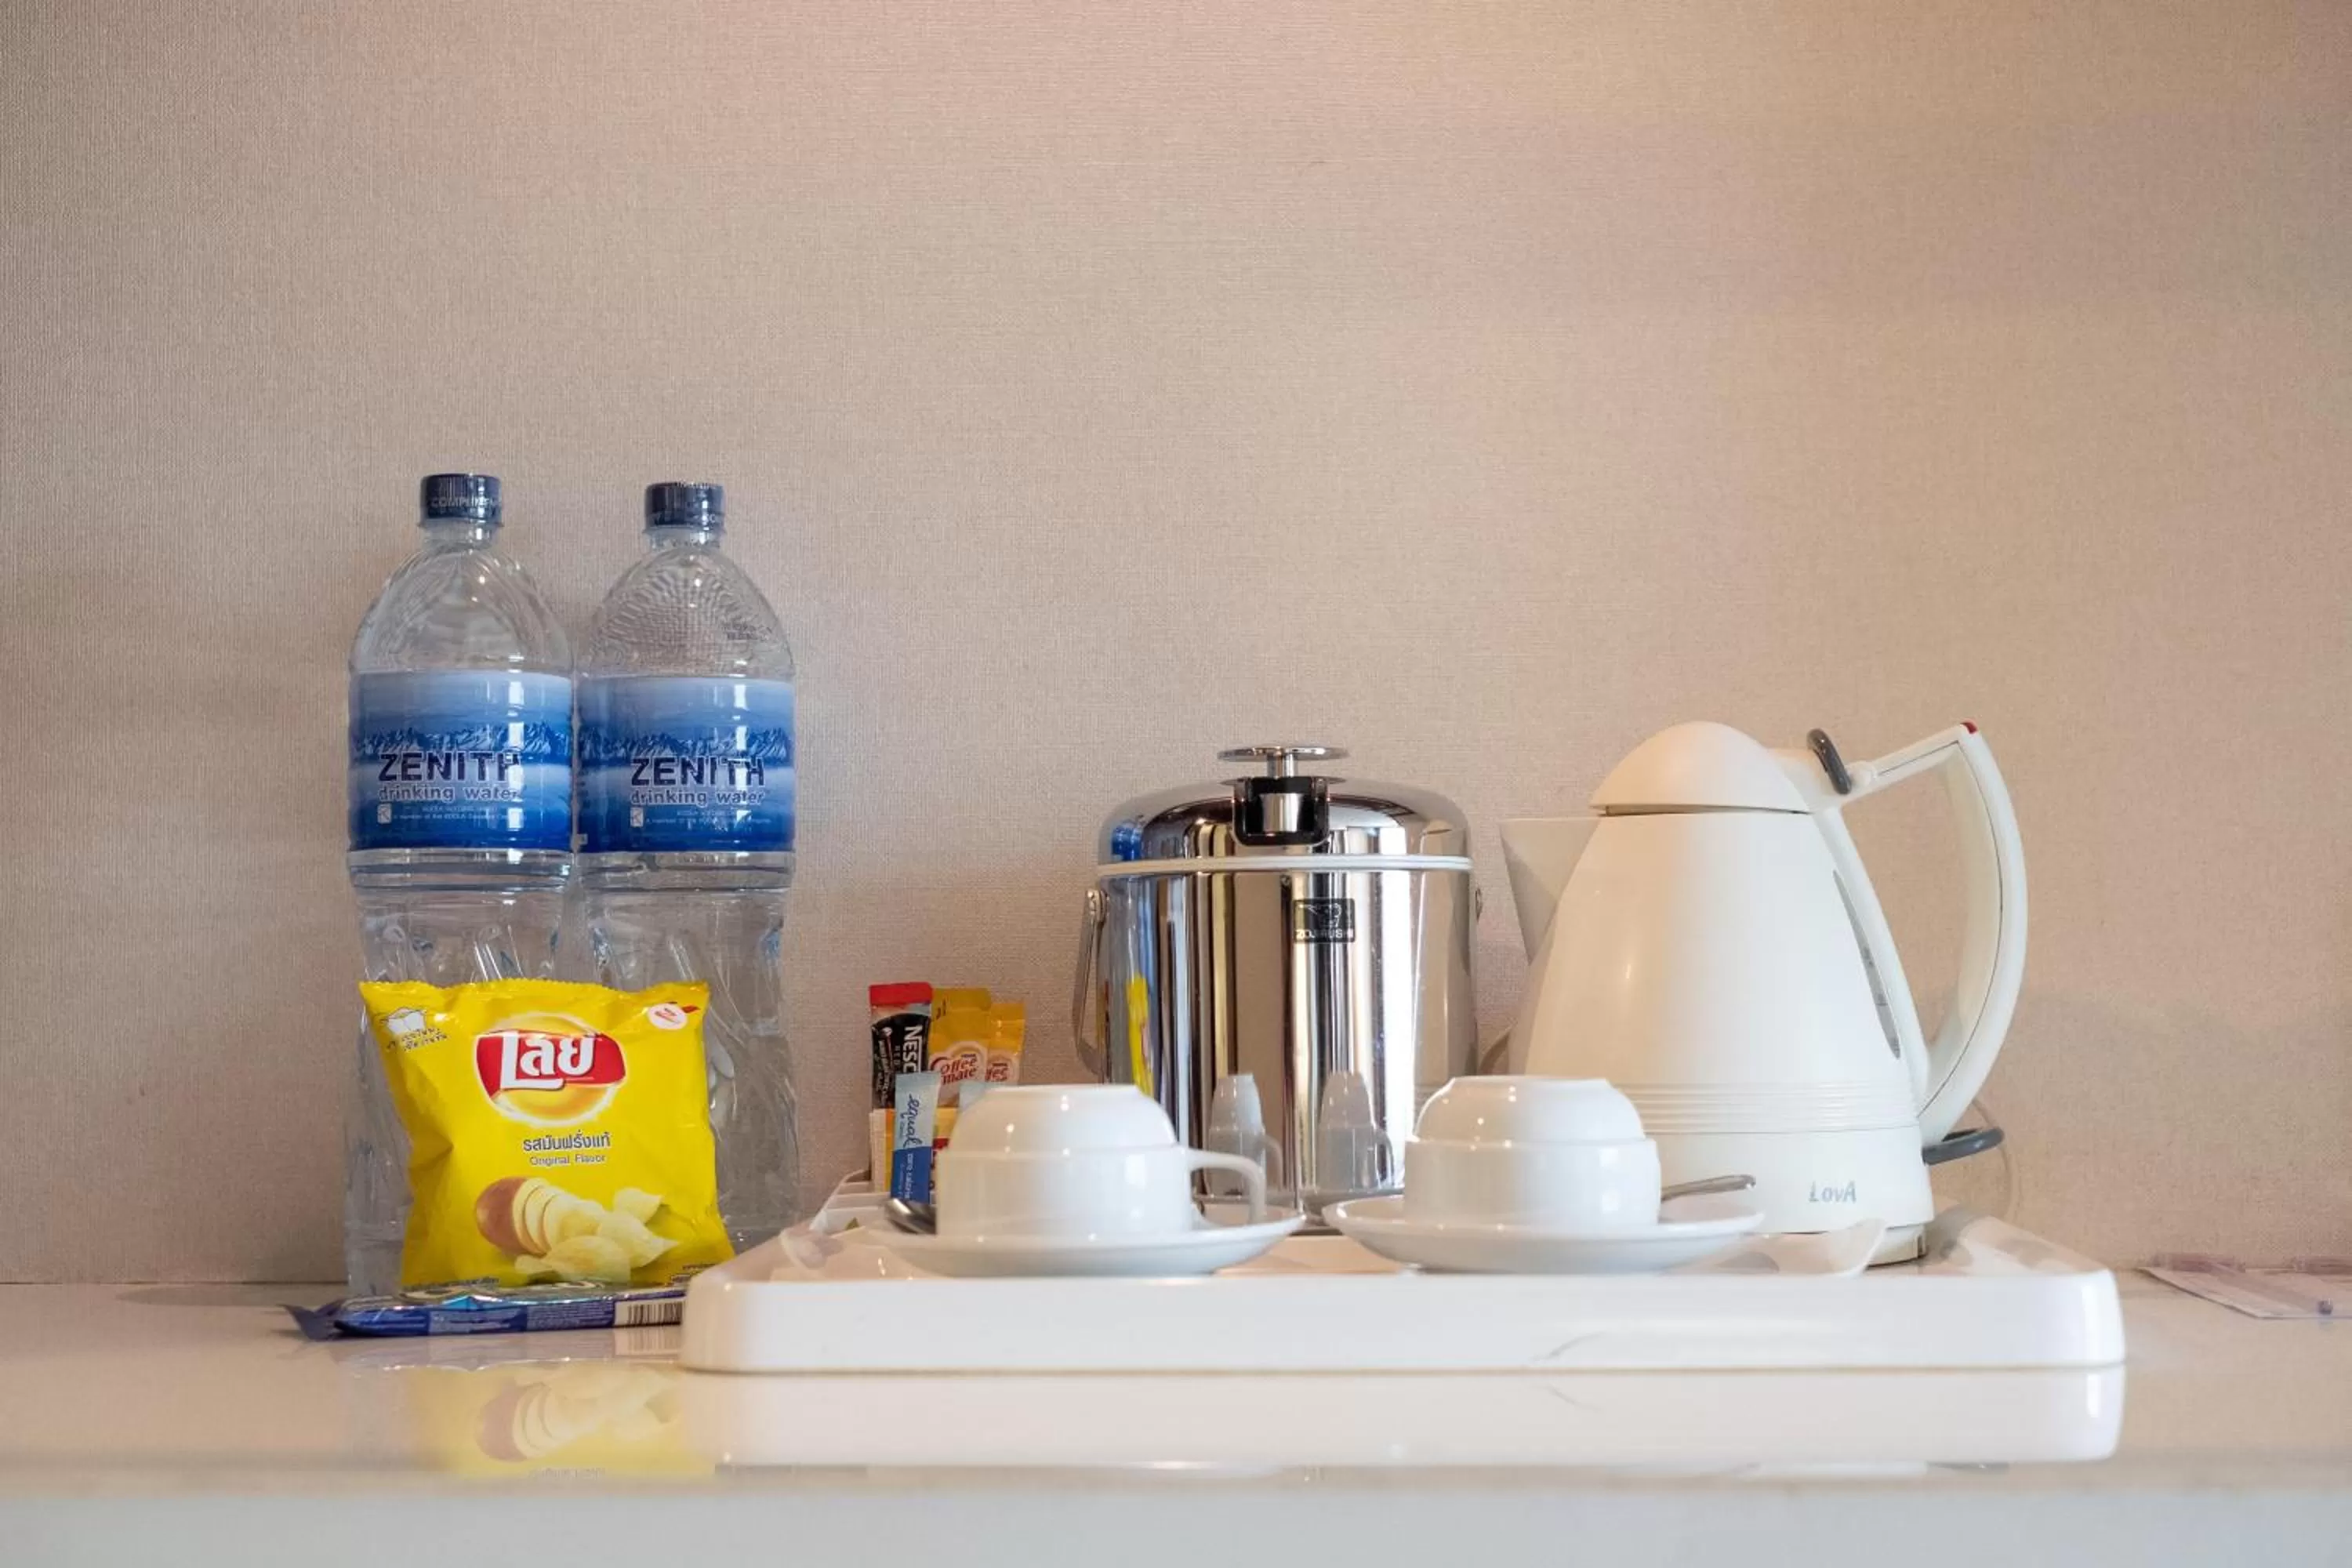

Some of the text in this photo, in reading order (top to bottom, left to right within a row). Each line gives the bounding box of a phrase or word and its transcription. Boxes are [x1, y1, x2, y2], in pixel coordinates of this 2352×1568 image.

[630, 757, 765, 786] ZENITH
[378, 785, 519, 801] drinking water
[630, 790, 765, 807] drinking water
[902, 1025, 922, 1073] NESC
[900, 1093, 923, 1148] equal
[529, 1153, 607, 1167] Original Flavor
